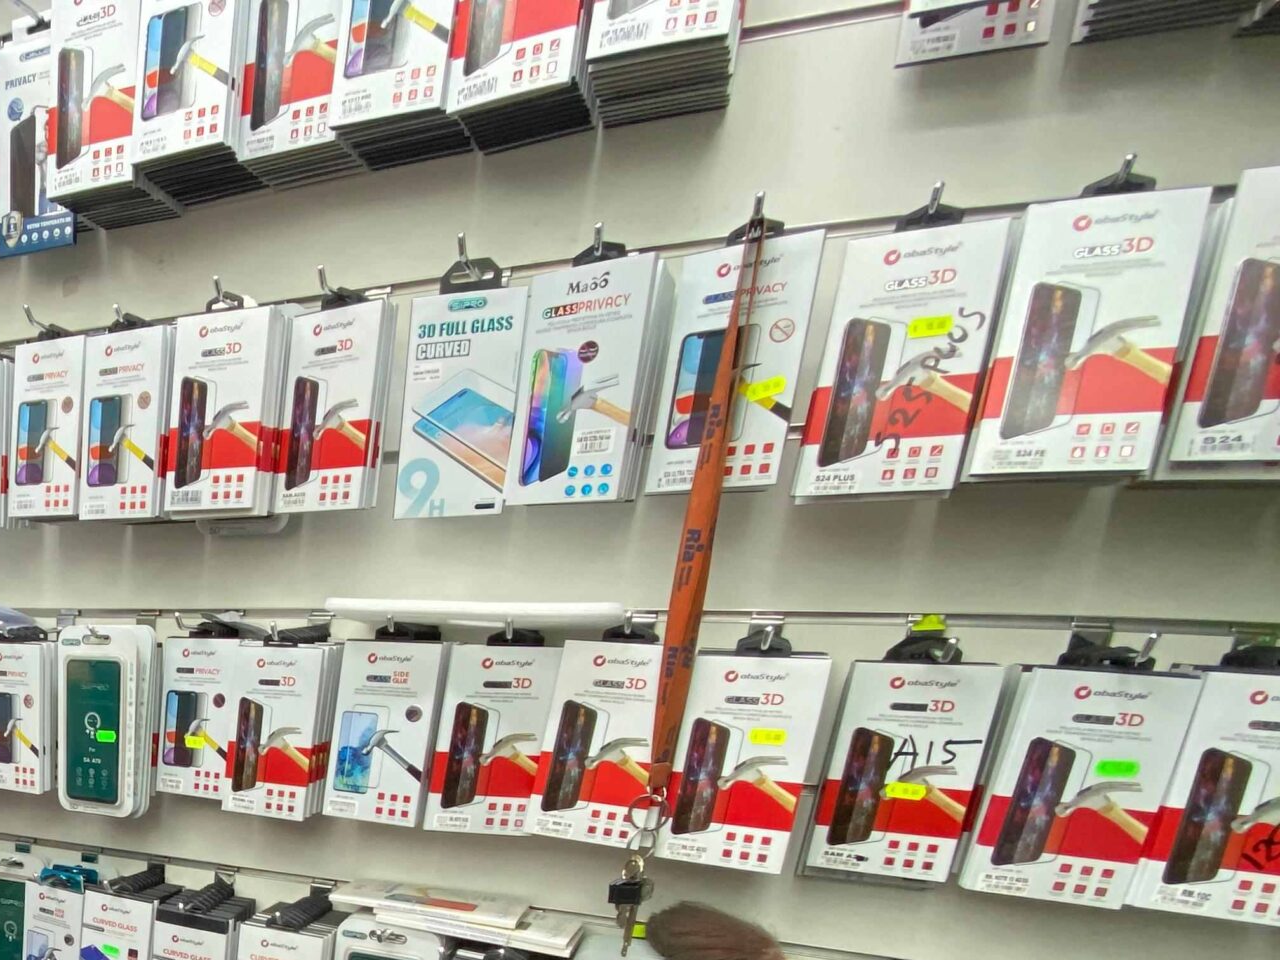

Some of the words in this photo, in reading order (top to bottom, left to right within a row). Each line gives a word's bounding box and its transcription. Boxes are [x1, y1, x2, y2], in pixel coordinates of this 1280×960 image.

[101, 4, 116, 17] 3D
[5, 73, 37, 91] PRIVACY
[903, 244, 959, 260] obaStyle
[1073, 244, 1121, 259] GLASS
[1122, 236, 1154, 254] 3D
[884, 277, 928, 292] GLASS
[928, 268, 957, 286] 3D
[542, 302, 579, 319] GLASS
[577, 294, 631, 312] PRIVACY
[210, 321, 242, 335] obaStyle
[418, 325, 436, 339] 3D
[439, 320, 469, 336] FULL
[471, 316, 514, 333] GLASS
[225, 343, 241, 354] 3D
[337, 339, 353, 351] 3D
[417, 340, 470, 360] CURVED
[118, 363, 144, 374] PRIVACY
[44, 370, 68, 381] PRIVACY
[1202, 434, 1244, 445] S24
[815, 474, 831, 482] S24
[832, 473, 856, 482] PLUS
[682, 528, 705, 563] Ria
[378, 655, 412, 664] obaStyle
[495, 659, 532, 668] obaStyle
[607, 659, 649, 668] obaStyle
[195, 668, 220, 676] PRIVACY
[740, 672, 786, 682] obaStyle
[280, 676, 296, 687] 3D
[392, 676, 408, 684] GLUE
[513, 678, 532, 689] 3D
[625, 678, 647, 690] 3D
[907, 679, 958, 689] obaStyle
[725, 696, 760, 705] GLASS
[761, 693, 784, 705] 3D
[1093, 689, 1149, 700] obaStyle
[929, 700, 955, 712] 3D
[1115, 712, 1145, 726] 3D
[887, 735, 983, 770] A15
[92, 917, 117, 928] CURVED
[118, 921, 138, 933] GLASS
[163, 948, 188, 959] CURVED
